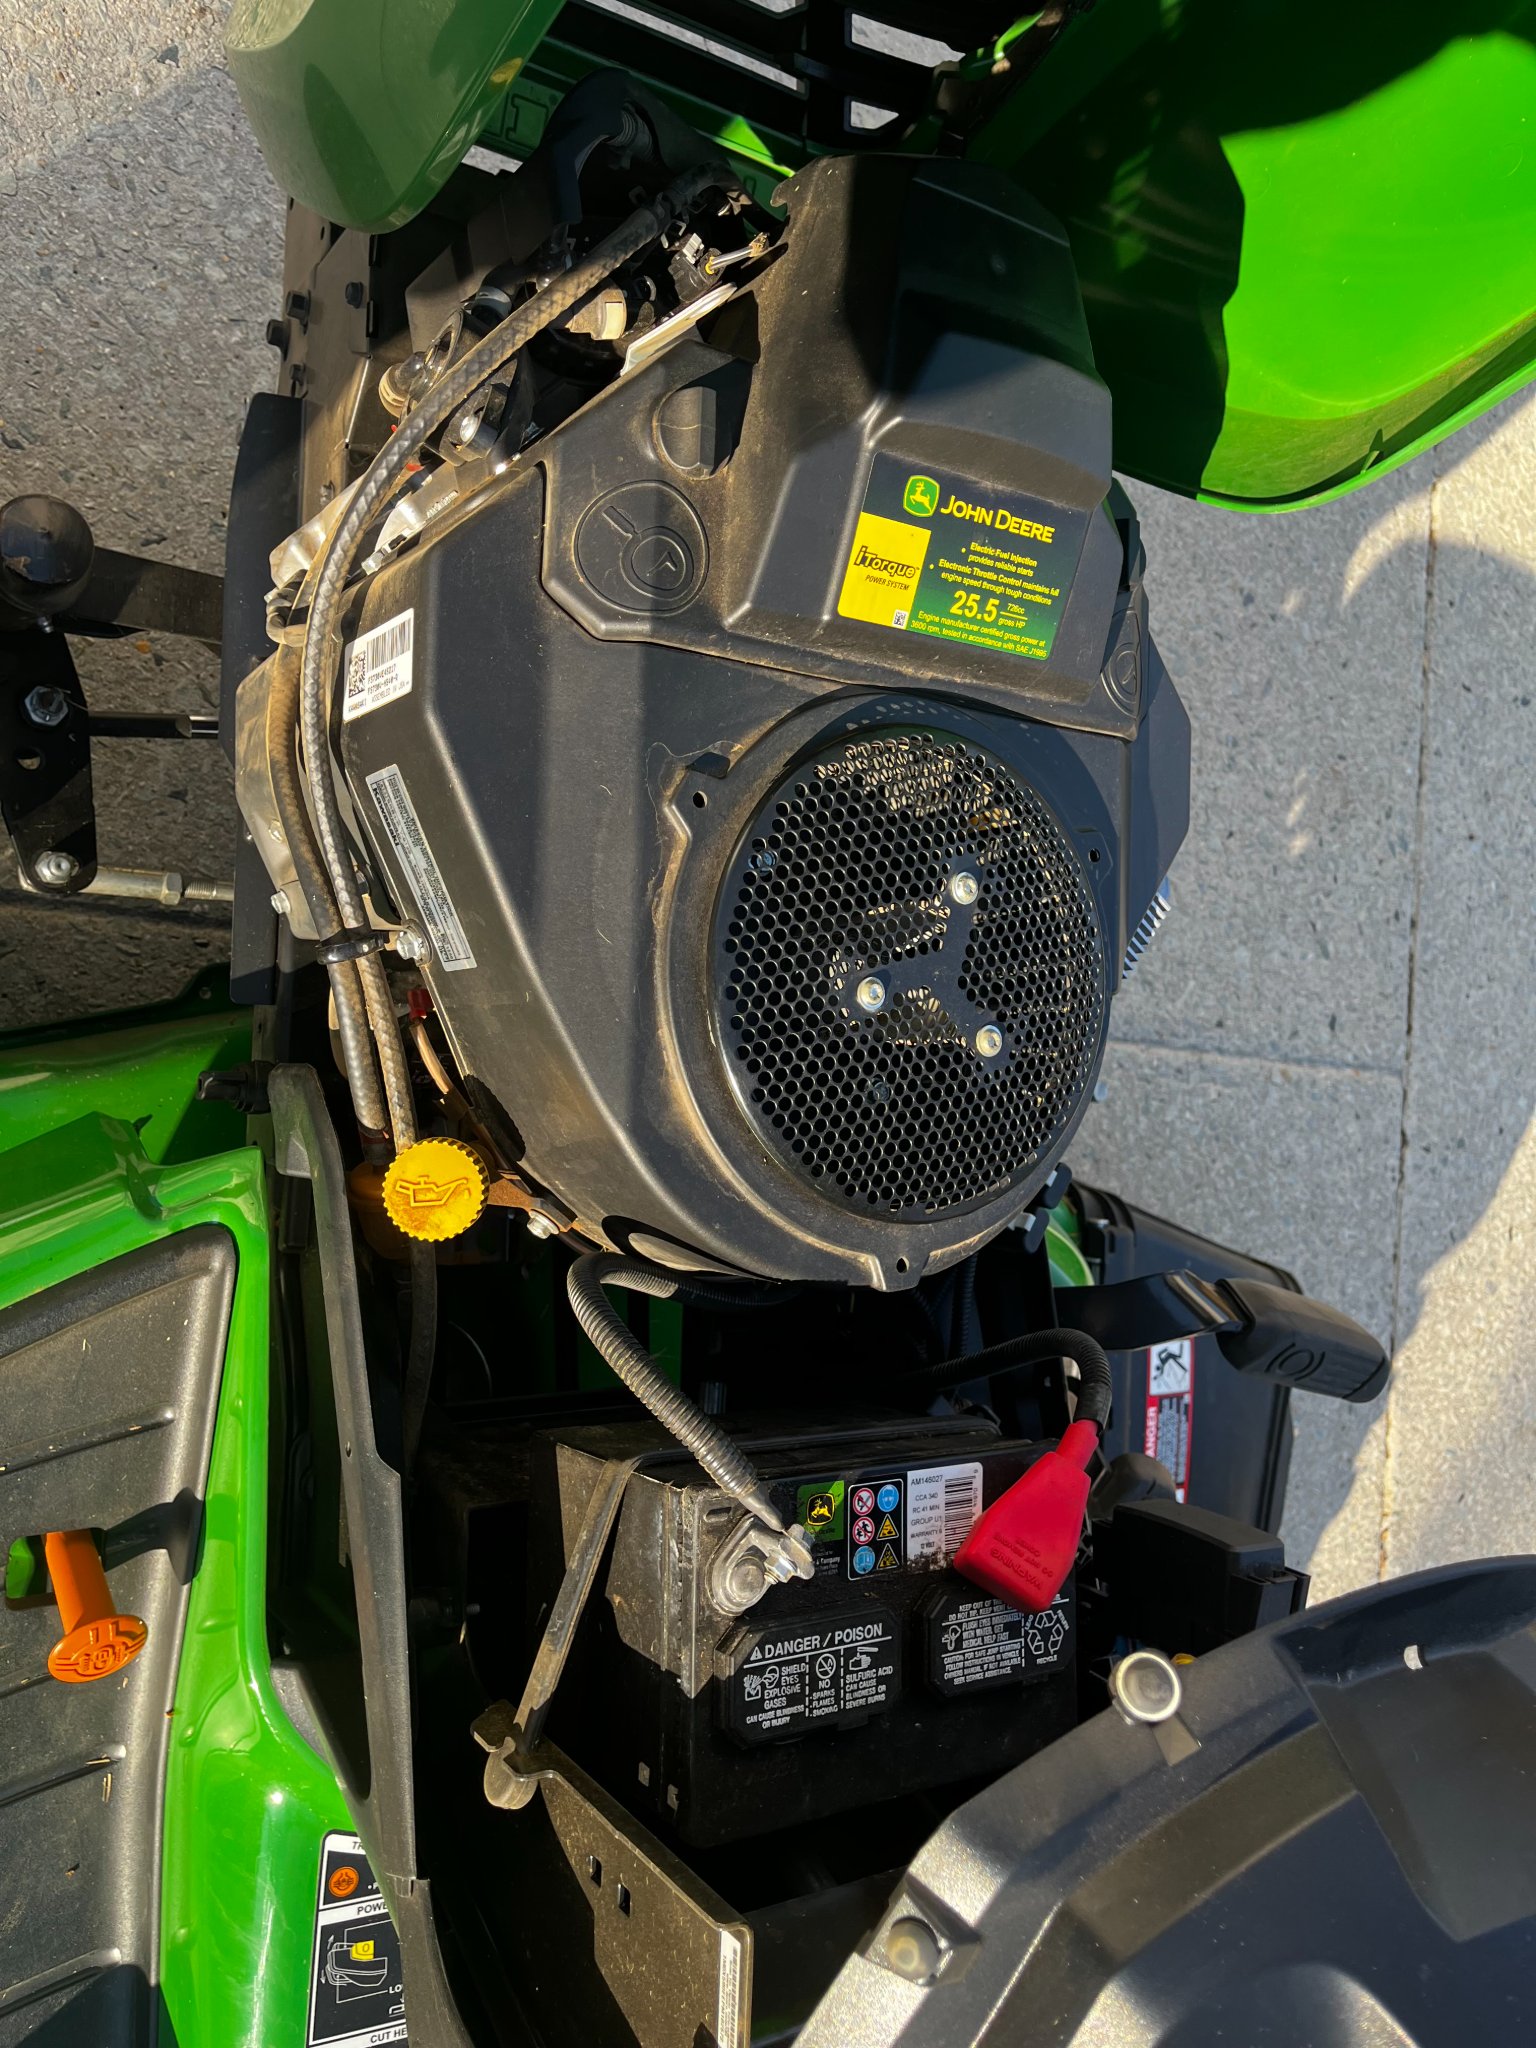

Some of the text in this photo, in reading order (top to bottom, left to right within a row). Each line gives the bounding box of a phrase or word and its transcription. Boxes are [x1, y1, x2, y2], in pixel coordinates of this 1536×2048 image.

[940, 495, 1054, 542] JOHN DEERE
[853, 545, 916, 579] iTorque
[967, 555, 1033, 576] provides reliable starts
[994, 549, 1010, 559] Fuel
[1010, 553, 1036, 566] Injection
[865, 574, 909, 590] POWER SYSTEM
[938, 559, 1059, 596] Electronic Throttle Control maintains full
[940, 572, 1051, 605] engine speed through tough conditions
[949, 590, 999, 622] 25.5
[917, 611, 939, 622] Engine
[940, 617, 979, 632] manufacturer
[979, 627, 1003, 637] certified
[1002, 632, 1020, 641] gross
[1019, 637, 1038, 645] power
[997, 617, 1014, 627] gross
[911, 621, 926, 630] 3600
[927, 625, 940, 634] rpm,
[941, 629, 959, 637] tested
[965, 634, 999, 647] accordance
[999, 641, 1014, 650] with
[1015, 644, 1027, 653] SAE
[372, 786, 401, 848] Kawasaki
[1144, 1406, 1158, 1456] ANGER
[910, 1516, 933, 1525] GROUP
[910, 1529, 937, 1538] WARRANTY
[959, 1603, 971, 1611] KEEP
[972, 1601, 983, 1609] OUT
[984, 1599, 991, 1607] OF
[948, 1613, 956, 1621] DO
[957, 1611, 967, 1619] NOT
[979, 1607, 990, 1615] KEEP
[962, 1620, 978, 1631] FLUSH
[978, 1618, 990, 1627] EYES
[962, 1630, 974, 1639] WITH
[993, 1624, 1003, 1633] GET
[764, 1623, 882, 1658] DANGER / POISON
[962, 1631, 1009, 1648] MEDICAL HELP FAST
[964, 1651, 973, 1659] FOR
[974, 1649, 986, 1657] SAFE
[986, 1646, 998, 1655] JUMP
[999, 1642, 1020, 1652] STARTING
[945, 1662, 963, 1671] FOLLOW
[964, 1655, 995, 1667] INSTRUCTIONS
[1001, 1649, 1019, 1659] VEHICLE
[1036, 1654, 1057, 1664] RECYCLE
[781, 1662, 805, 1675] SHIELD
[845, 1665, 893, 1683] SULFURIC ACID
[943, 1670, 963, 1679] OWNERS
[999, 1657, 1020, 1666] AVAILABLE
[780, 1674, 798, 1685] EYES
[818, 1678, 830, 1689] NO
[845, 1678, 876, 1691] CAN CAUSE
[953, 1676, 965, 1684] SEEK
[965, 1672, 983, 1682] SERVICE
[764, 1683, 800, 1698] EXPLOSIVE
[812, 1688, 835, 1699] SPARKS
[845, 1684, 886, 1700] BLINDNESS OR
[763, 1697, 786, 1709] GASES
[812, 1697, 834, 1707] FLAMES
[845, 1693, 885, 1709] SEVERE BURNS
[746, 1704, 804, 1723] CAN CAUSE BLINDNESS
[812, 1704, 838, 1716] SMOKING
[761, 1716, 790, 1728] OR INJURY
[370, 2032, 391, 2043] CUT
